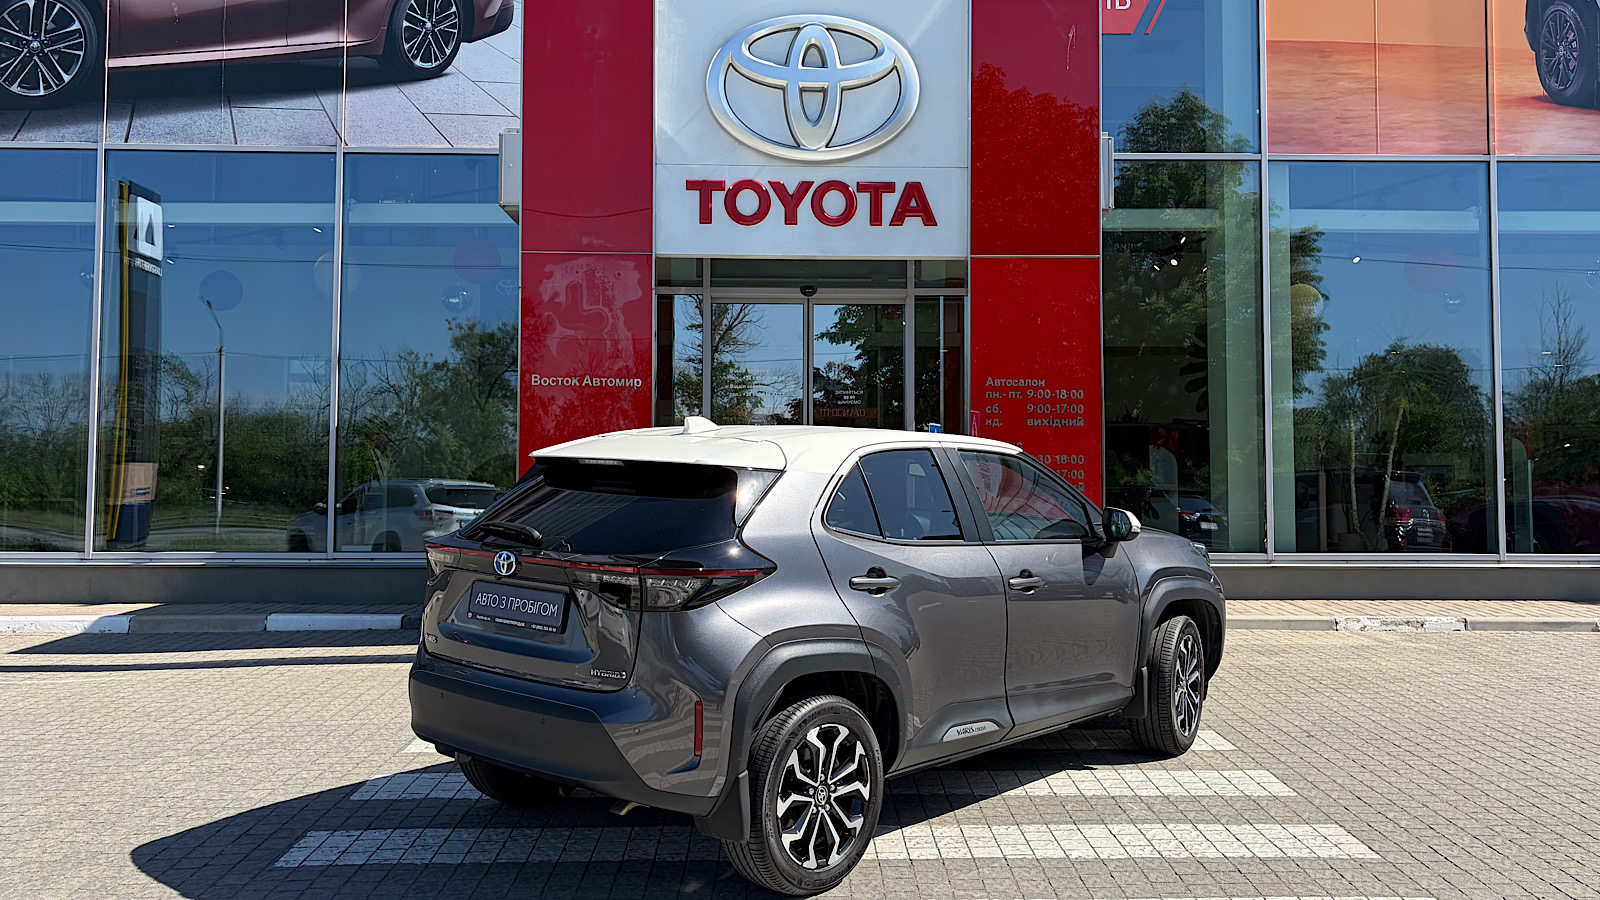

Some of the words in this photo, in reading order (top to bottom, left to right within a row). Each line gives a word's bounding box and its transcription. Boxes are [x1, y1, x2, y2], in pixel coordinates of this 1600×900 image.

[686, 179, 938, 227] TOYOTA
[531, 374, 580, 386] Восток
[582, 375, 642, 390] Автомир
[985, 377, 1046, 387] Автосалон
[1027, 389, 1084, 399] 9:00-18:00
[985, 404, 1002, 413] сб.
[1027, 404, 1084, 414] 9:00-17:00
[985, 418, 1003, 427] нд.
[1027, 416, 1085, 428] вихідний
[475, 592, 499, 607] АВТО
[507, 597, 559, 618] ПРОБІГОМ
[590, 669, 621, 679] HYBRID
